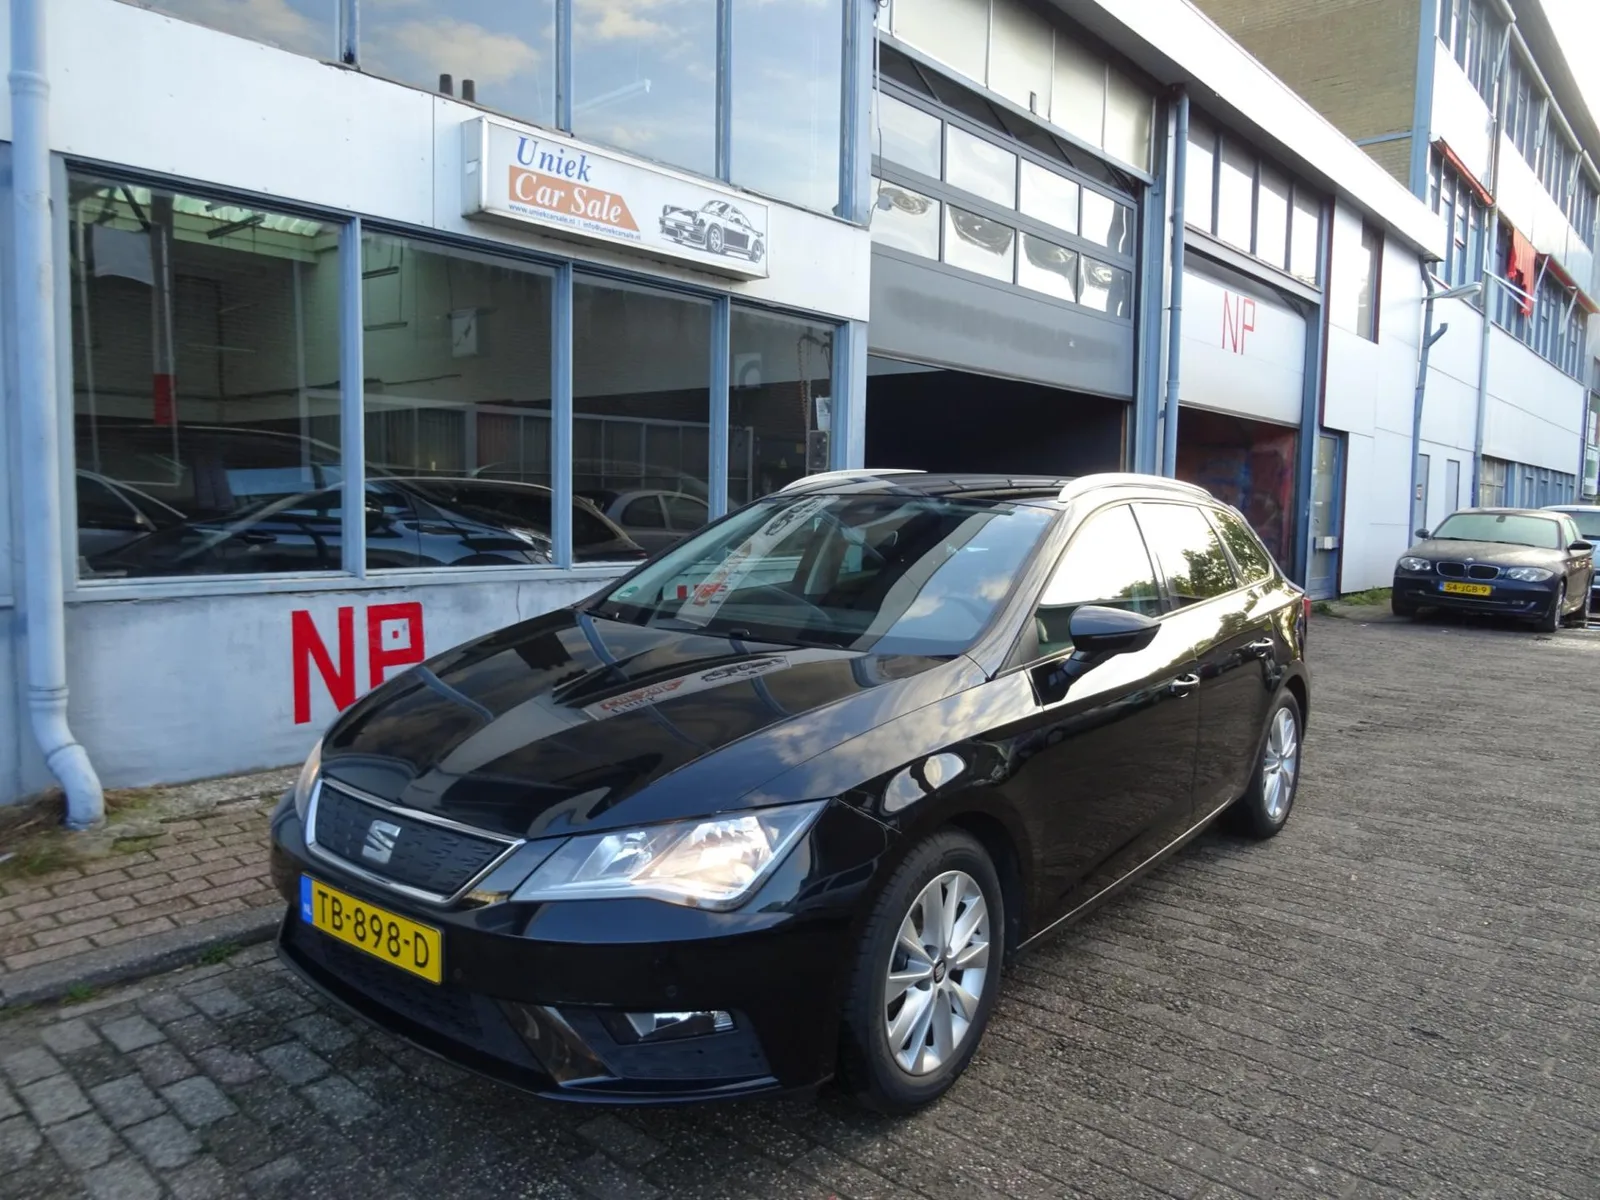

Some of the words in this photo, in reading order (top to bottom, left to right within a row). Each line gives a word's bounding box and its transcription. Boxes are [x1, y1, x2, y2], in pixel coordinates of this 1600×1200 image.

[517, 136, 591, 183] Uniek
[508, 203, 576, 225] www.uniekcarsale.nl
[515, 172, 565, 208] Car
[571, 187, 622, 223] Sale
[1222, 290, 1256, 355] NP
[1445, 583, 1488, 594] 54-JGB-9
[291, 602, 425, 724] NP
[317, 889, 430, 969] TB-898-D
